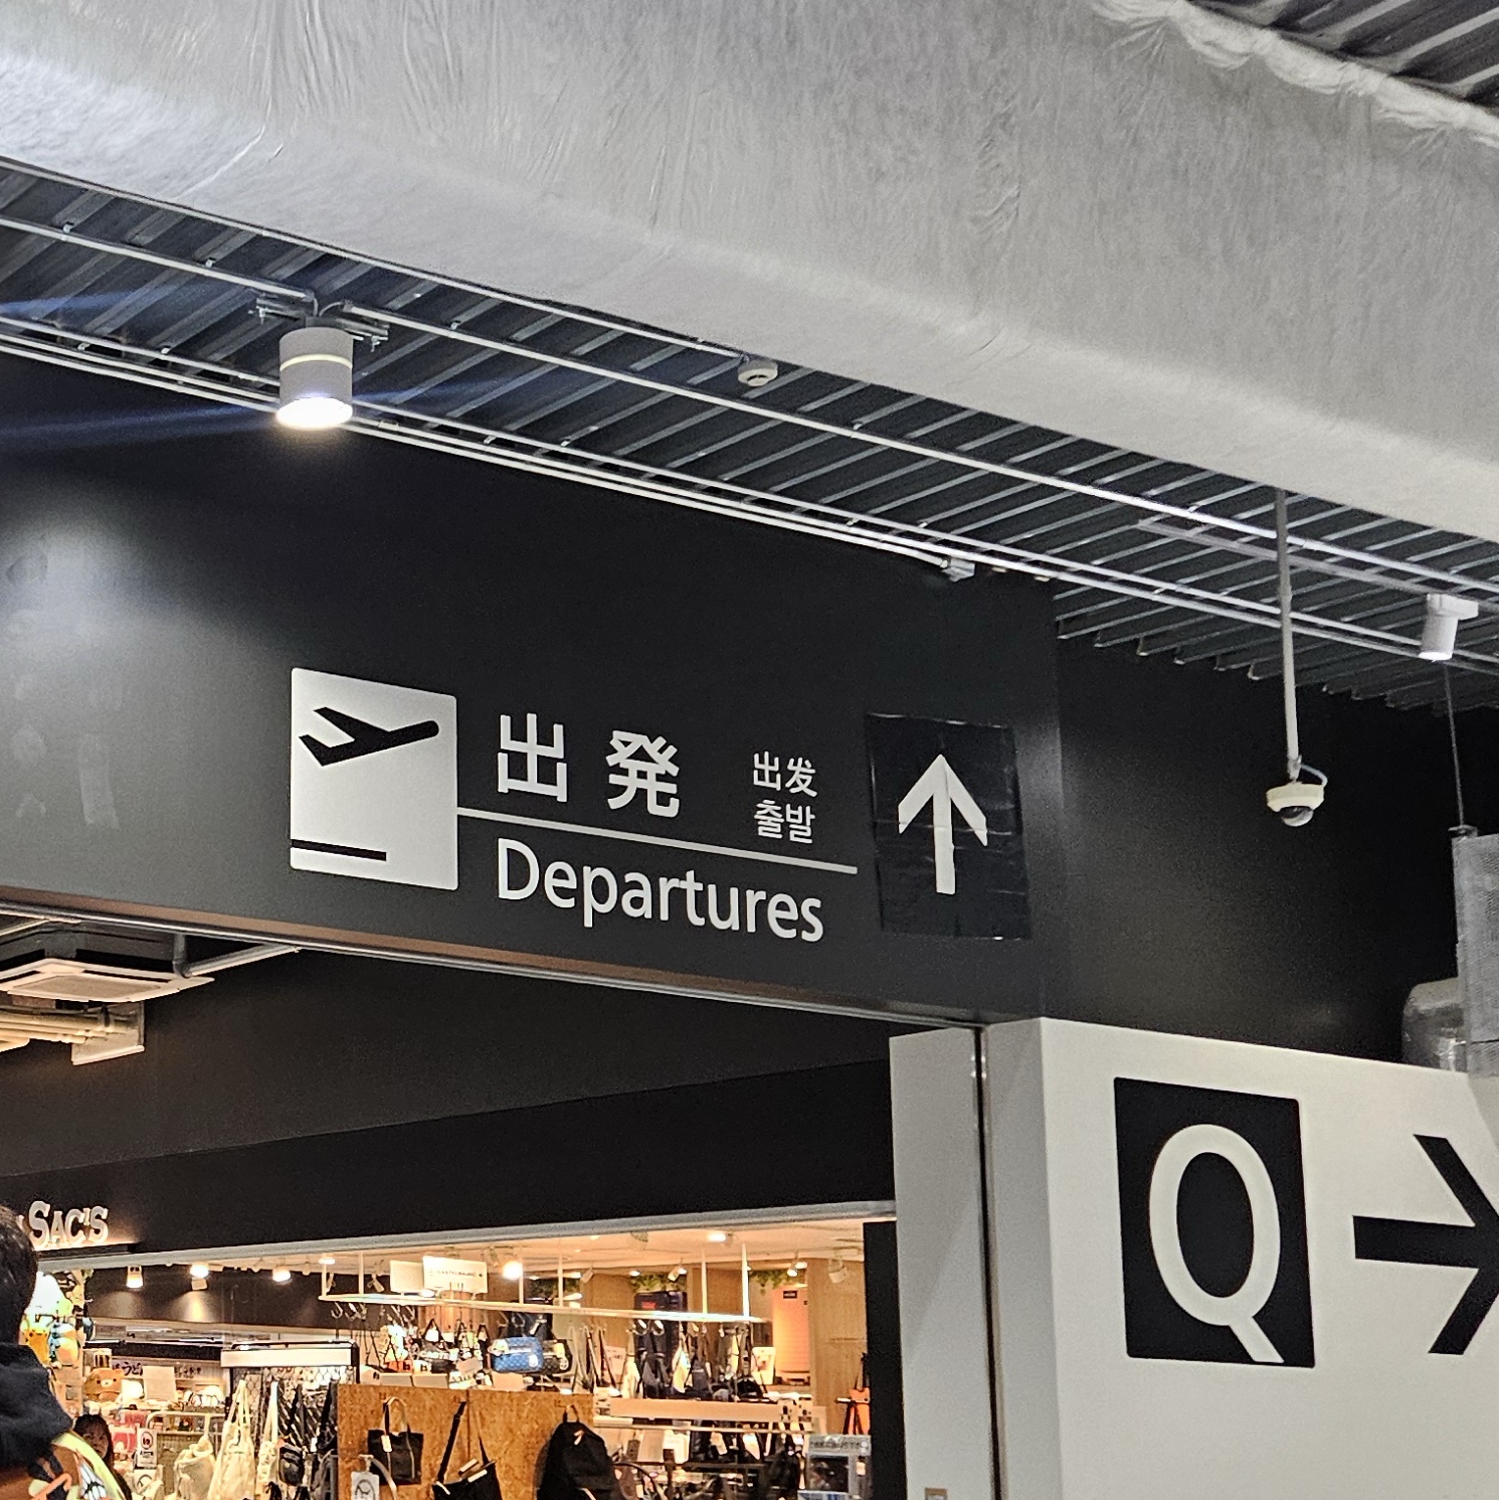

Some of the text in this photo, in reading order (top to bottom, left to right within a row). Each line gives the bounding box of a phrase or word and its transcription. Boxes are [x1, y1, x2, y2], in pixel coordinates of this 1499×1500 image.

[753, 750, 818, 798] 出发
[754, 800, 816, 844] 출발
[498, 838, 824, 943] Departures
[1148, 1122, 1285, 1364] Q
